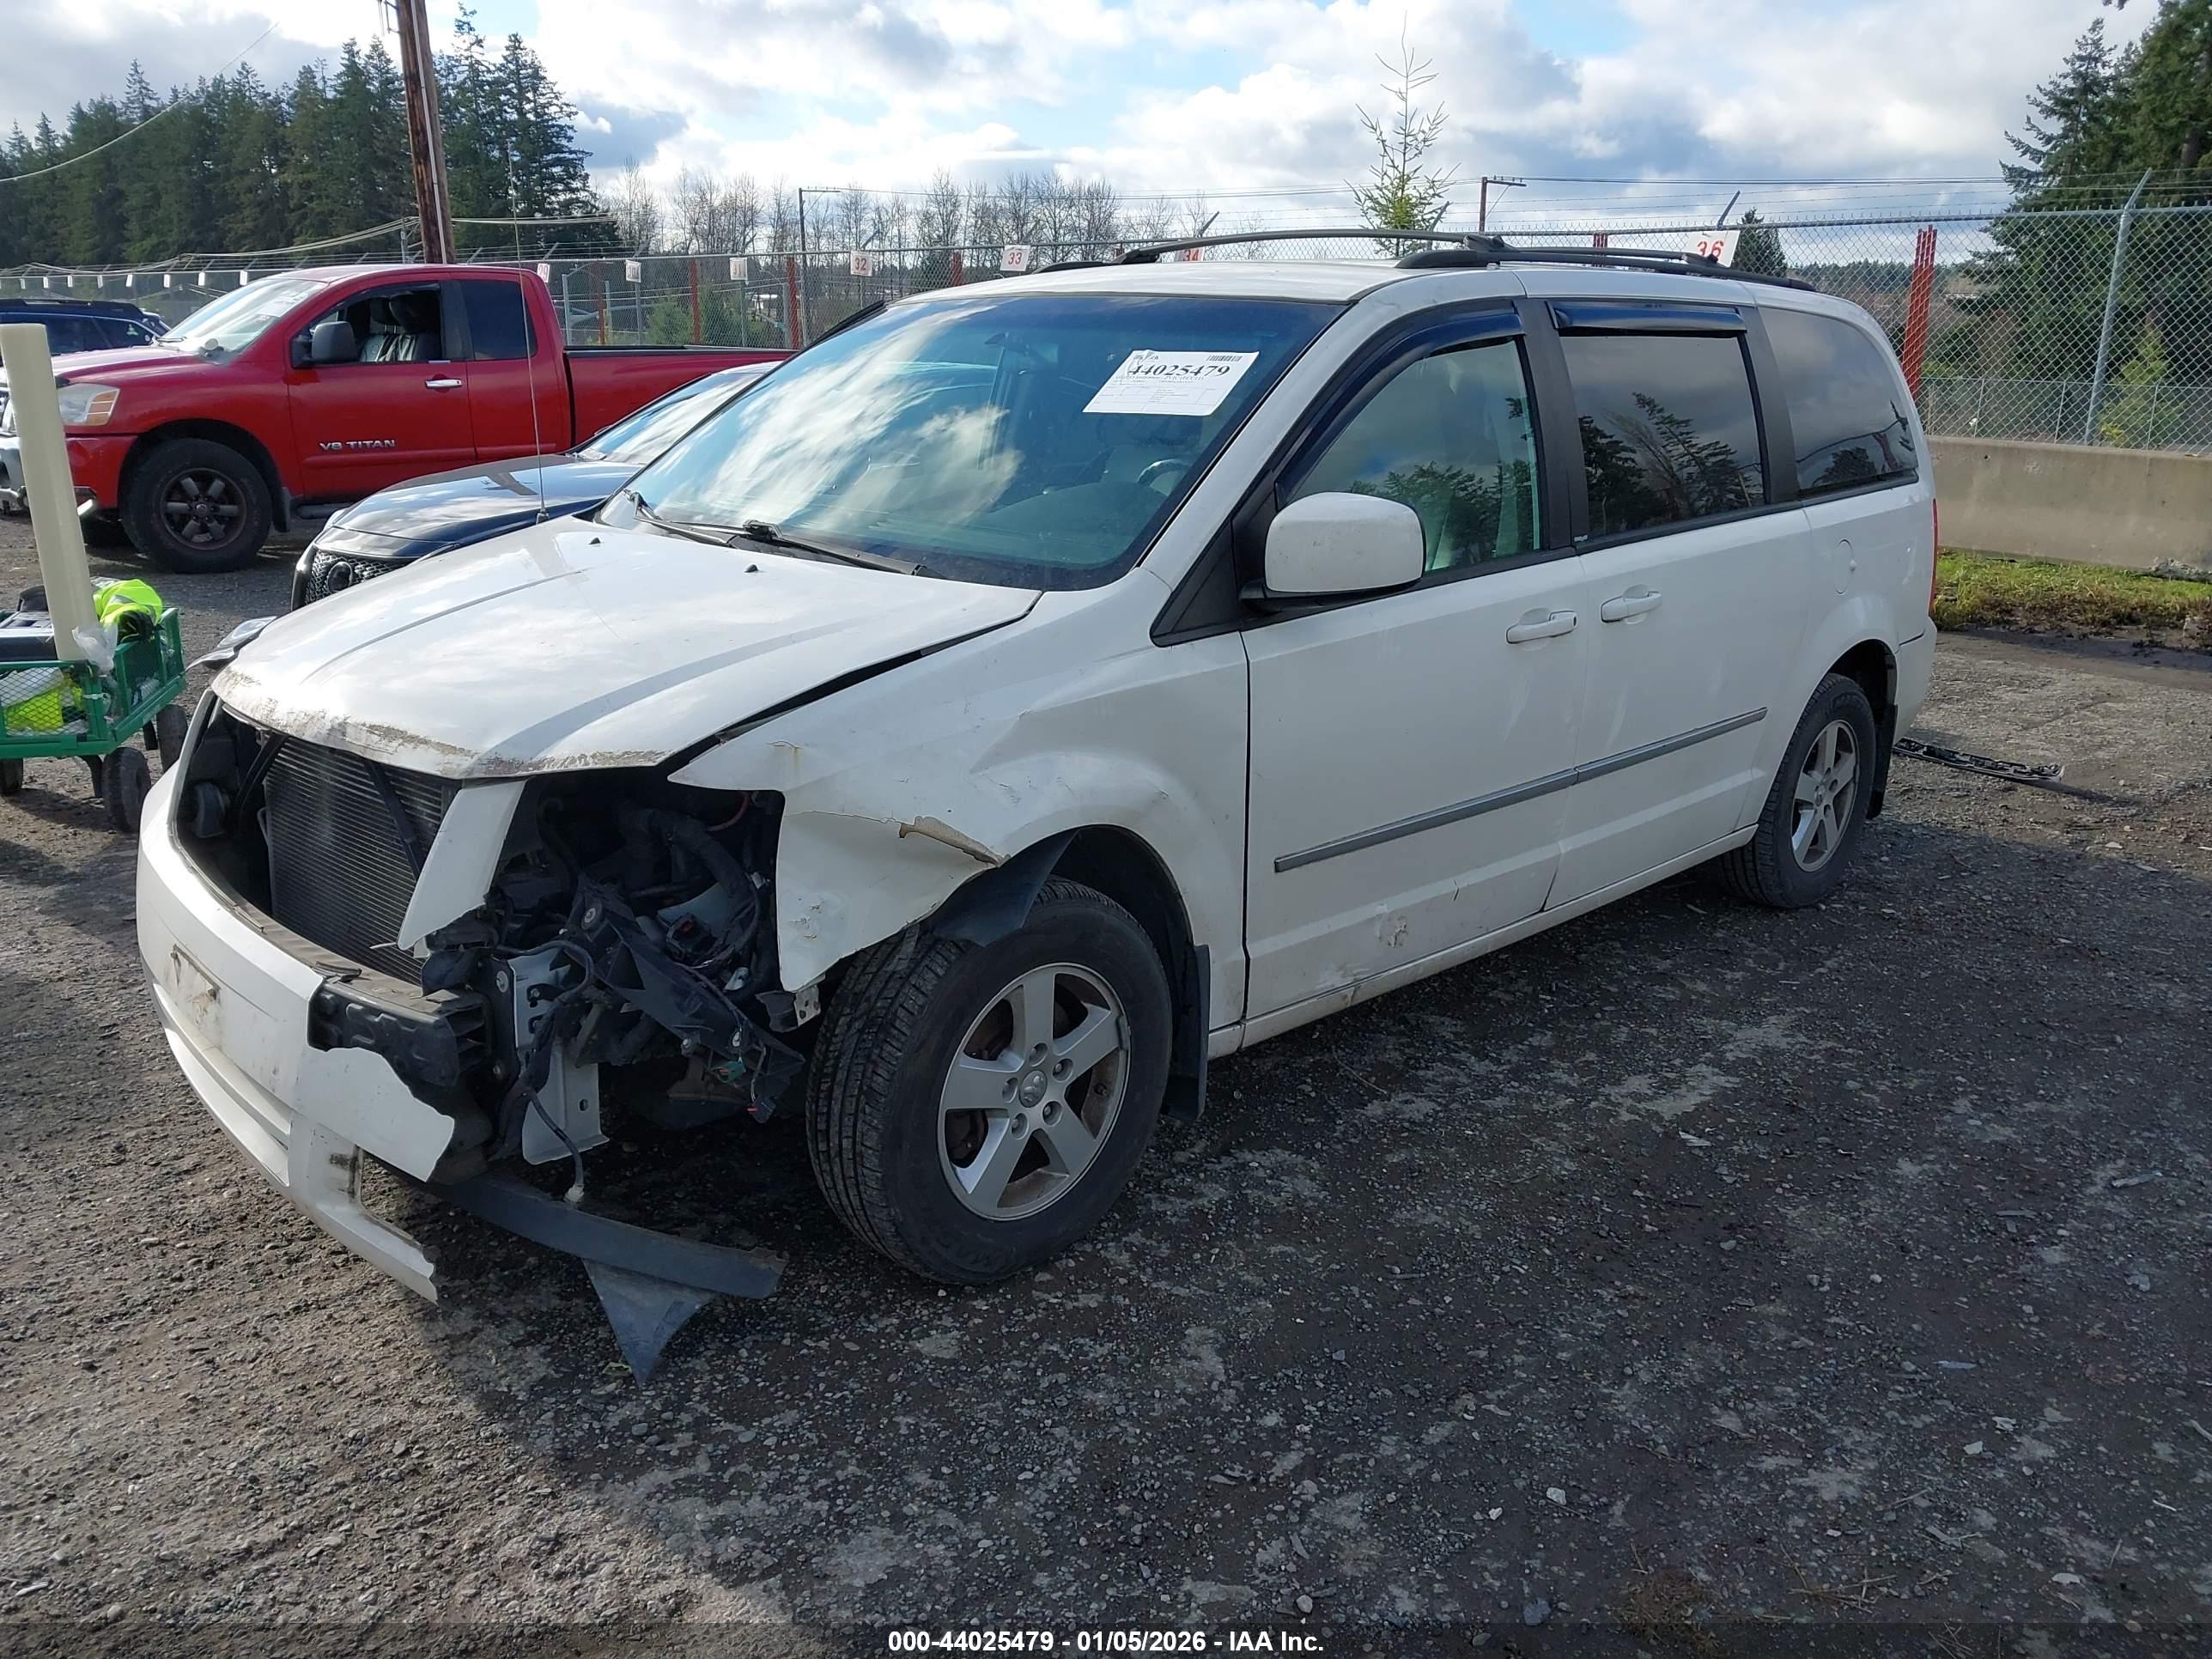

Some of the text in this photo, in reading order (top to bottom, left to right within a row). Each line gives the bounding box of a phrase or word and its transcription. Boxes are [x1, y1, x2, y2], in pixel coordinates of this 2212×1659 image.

[854, 257, 867, 270] 32
[1007, 252, 1023, 265] 33
[538, 264, 549, 282] 29
[1127, 364, 1231, 376] 44025479
[319, 439, 396, 451] V8 TITAN
